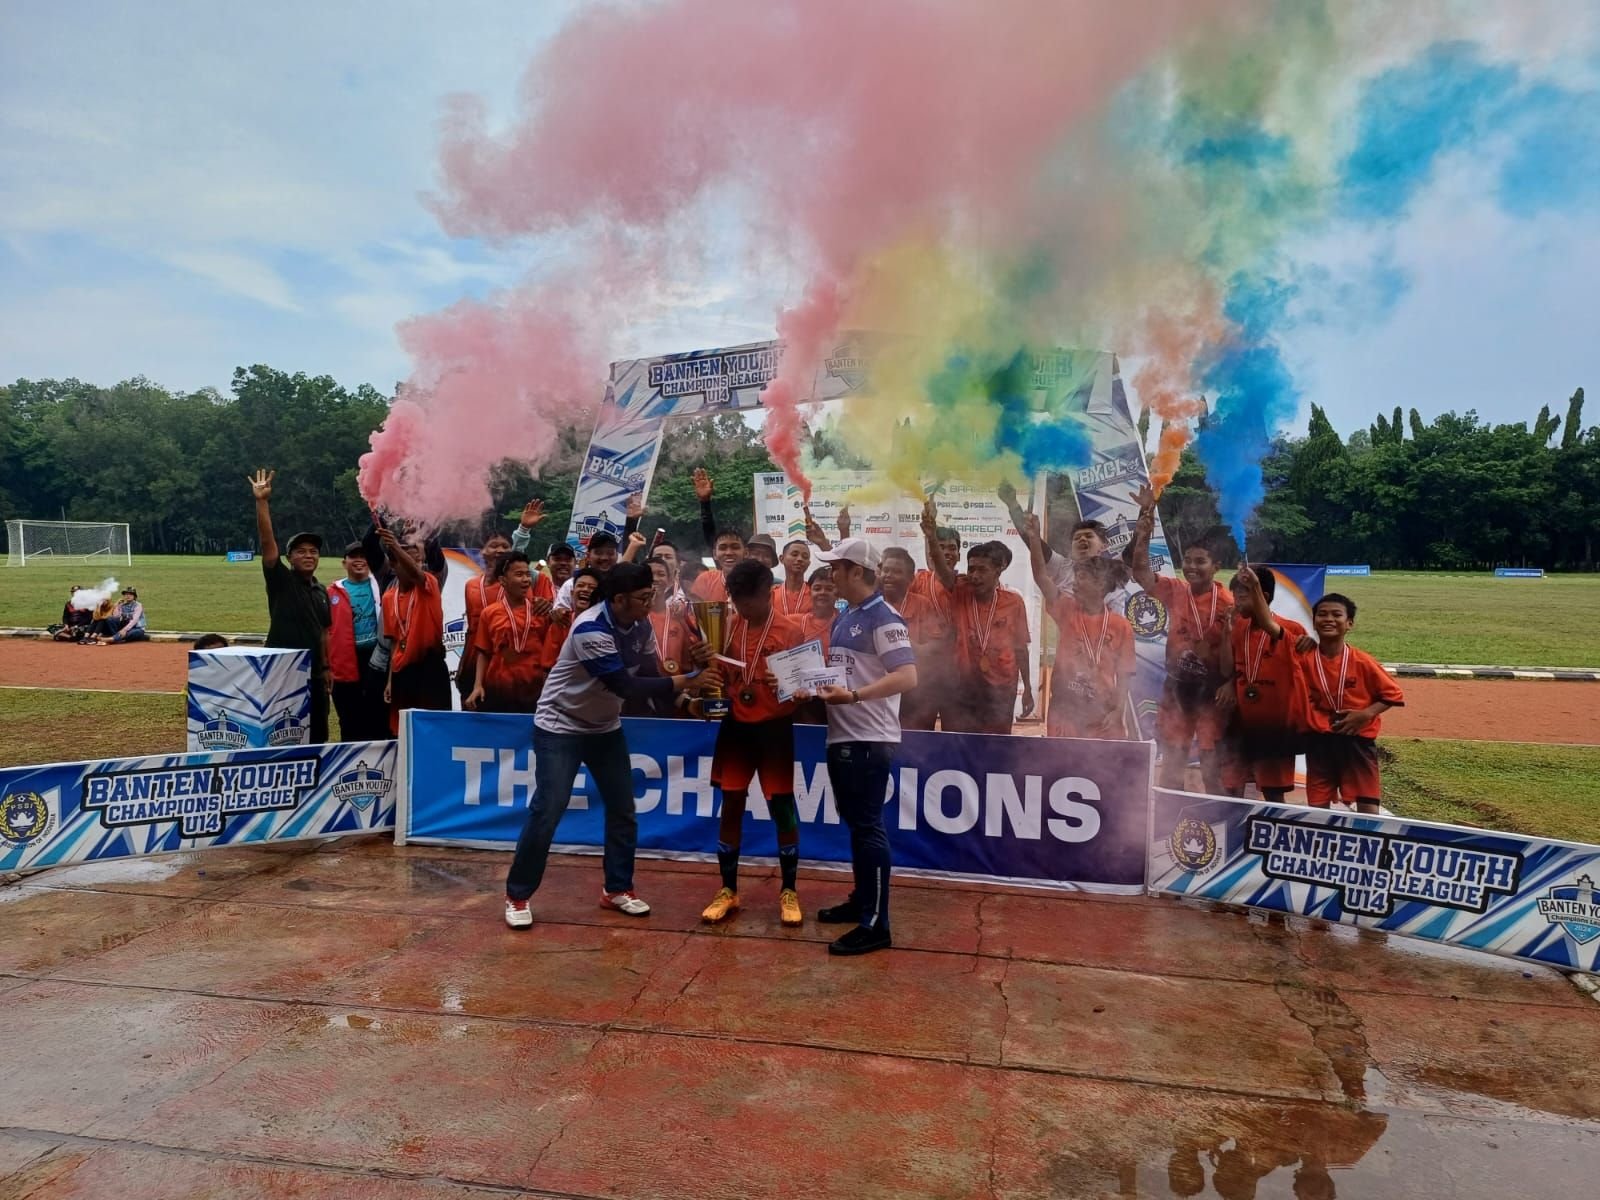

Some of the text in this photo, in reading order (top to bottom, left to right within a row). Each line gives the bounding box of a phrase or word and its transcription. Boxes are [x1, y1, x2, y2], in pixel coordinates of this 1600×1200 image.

[652, 358, 721, 384] BANTEN
[664, 376, 728, 396] CHAMPIONS
[707, 388, 729, 403] U14
[589, 456, 628, 482] BYCL
[1078, 458, 1127, 486] BYCL
[199, 731, 246, 745] BANTEN YOUTH
[89, 760, 315, 805] BANTEN YOUTH
[334, 780, 390, 795] BANTEN YOUTH
[11, 802, 33, 811] PSSI
[107, 790, 292, 821] CHAMPIONS LEAGUE
[631, 753, 1101, 843] CHAMIONS
[185, 814, 220, 833] U14
[1251, 821, 1514, 888] BANTEN YOUTH
[1269, 853, 1481, 907] CHAMPIONS LEAGUE
[1347, 887, 1386, 912] U14
[1541, 899, 1586, 915] BANTEN
